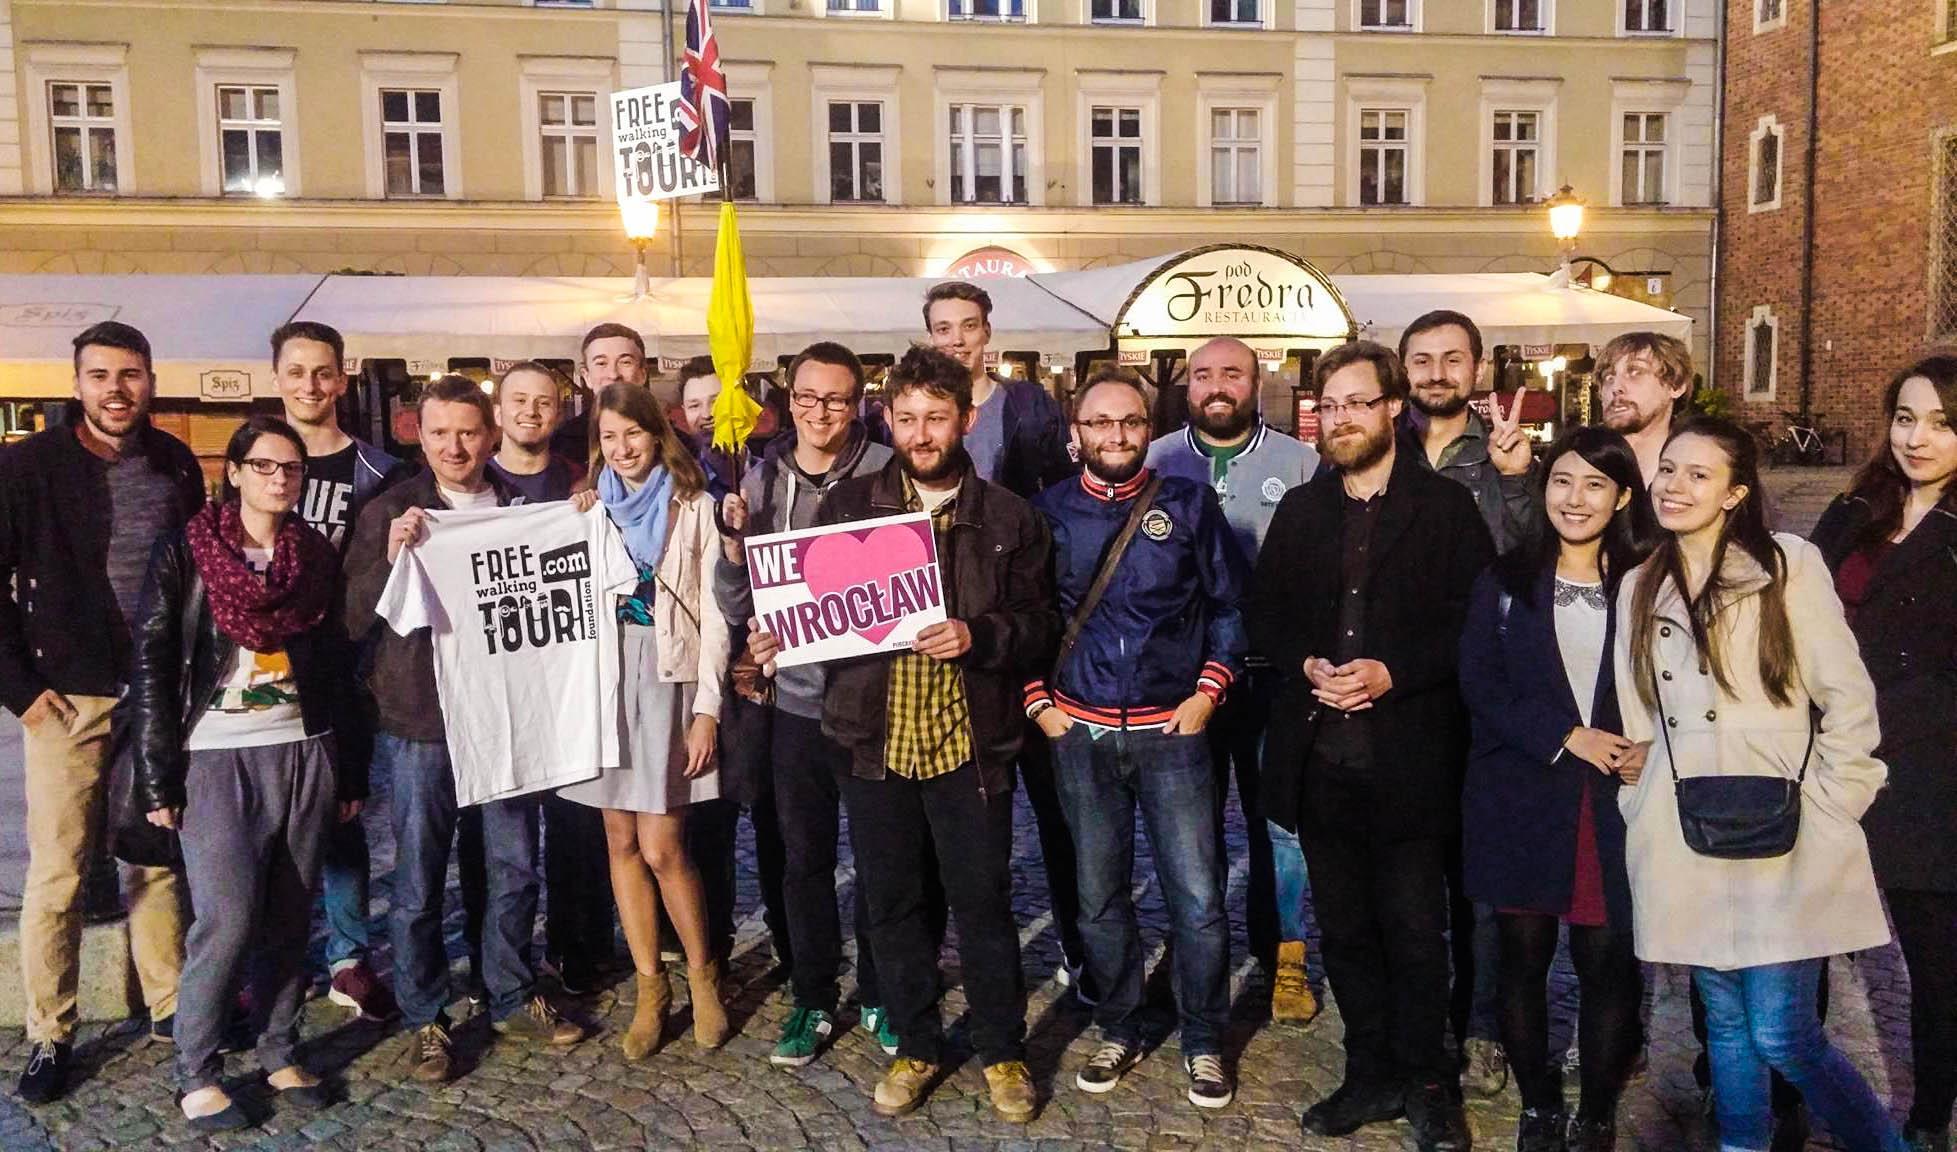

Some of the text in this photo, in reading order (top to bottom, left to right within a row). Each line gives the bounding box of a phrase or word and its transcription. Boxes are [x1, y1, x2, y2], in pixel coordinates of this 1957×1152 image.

[616, 93, 665, 130] FREE
[618, 127, 667, 143] walking
[620, 141, 698, 197] TOUR
[1225, 261, 1252, 280] pod
[1120, 351, 1146, 361] TYSKIE
[1256, 349, 1282, 360] TYSKIE
[302, 478, 353, 525] UE
[471, 544, 535, 584] FREE
[542, 551, 588, 576] .com
[752, 543, 801, 585] WE
[476, 580, 537, 598] walking
[478, 588, 577, 655] TOUR
[583, 581, 597, 640] foundation
[763, 565, 940, 652] WROCŁAW
